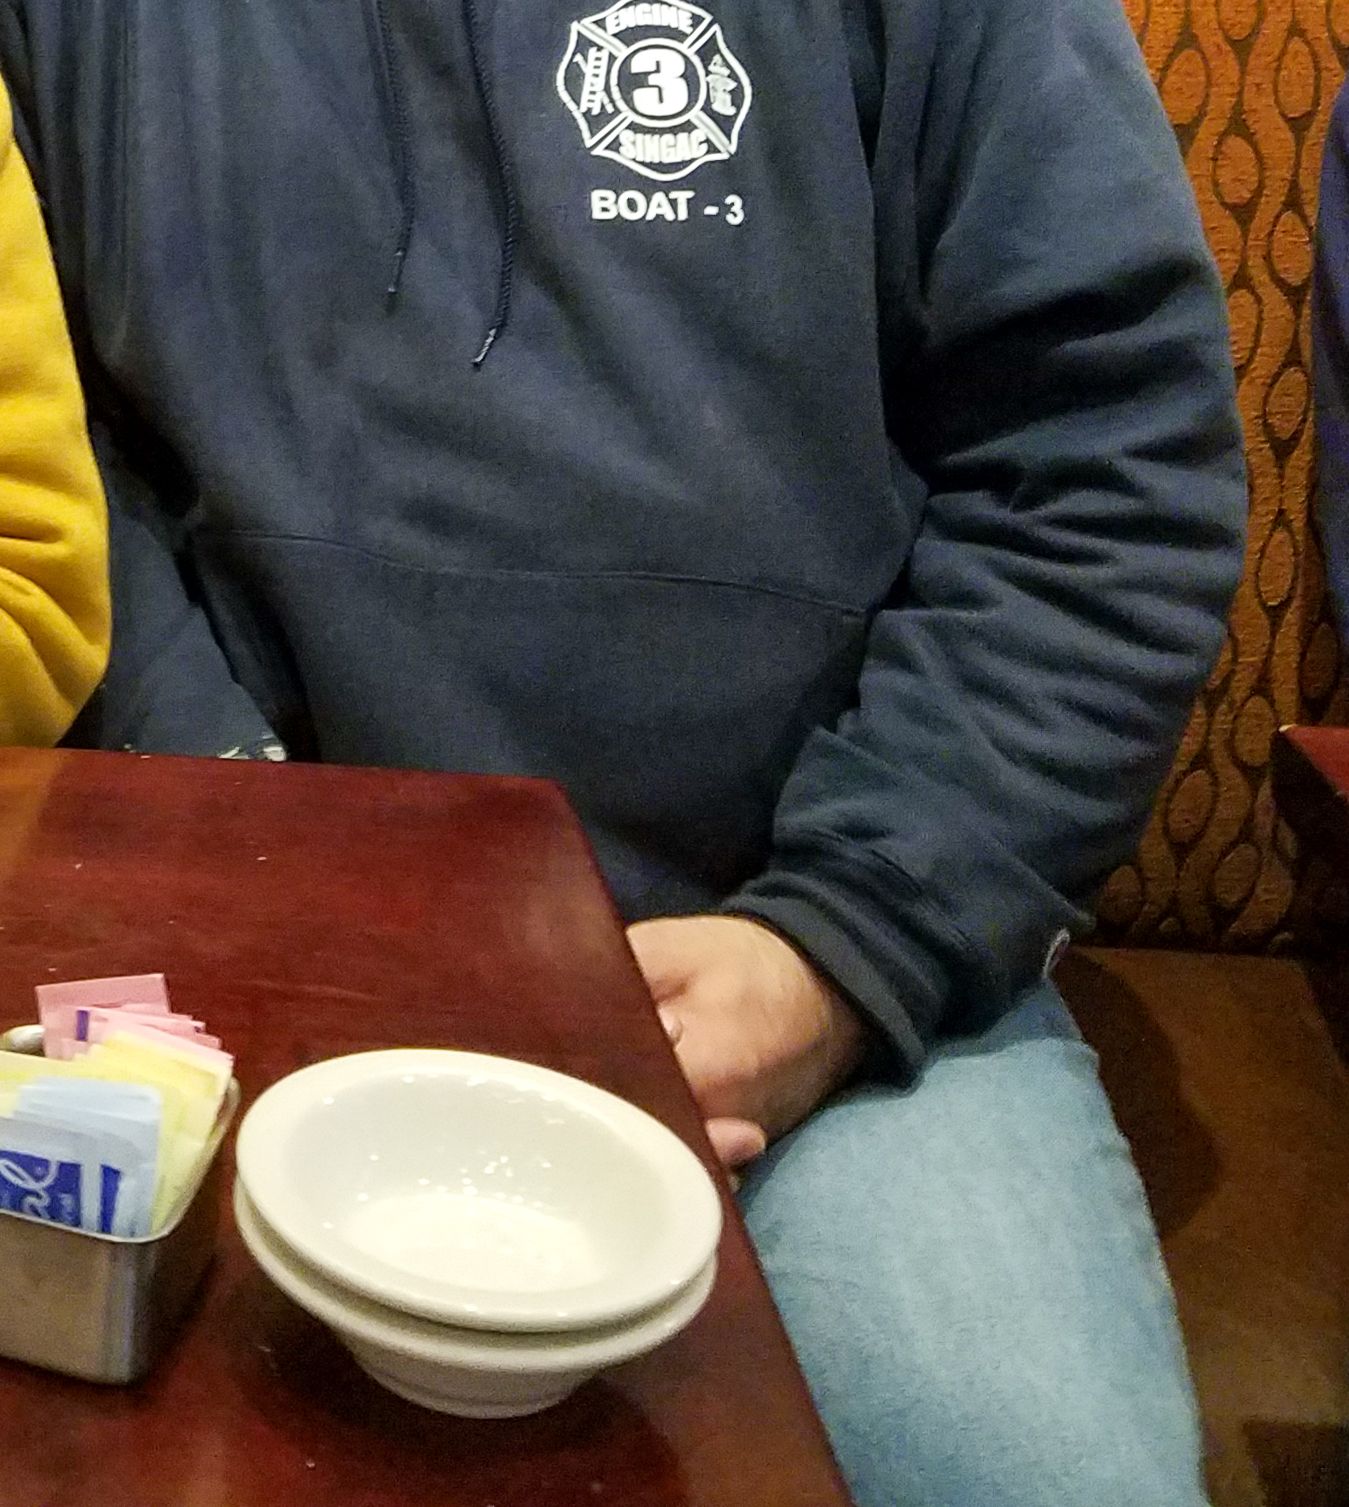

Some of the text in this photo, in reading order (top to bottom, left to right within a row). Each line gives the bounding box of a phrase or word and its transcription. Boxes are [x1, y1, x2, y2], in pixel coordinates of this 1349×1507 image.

[605, 2, 693, 35] ENGINE
[630, 48, 690, 117] 3
[618, 128, 708, 164] SINGAC
[590, 189, 695, 221] BOAT
[724, 194, 745, 225] 3
